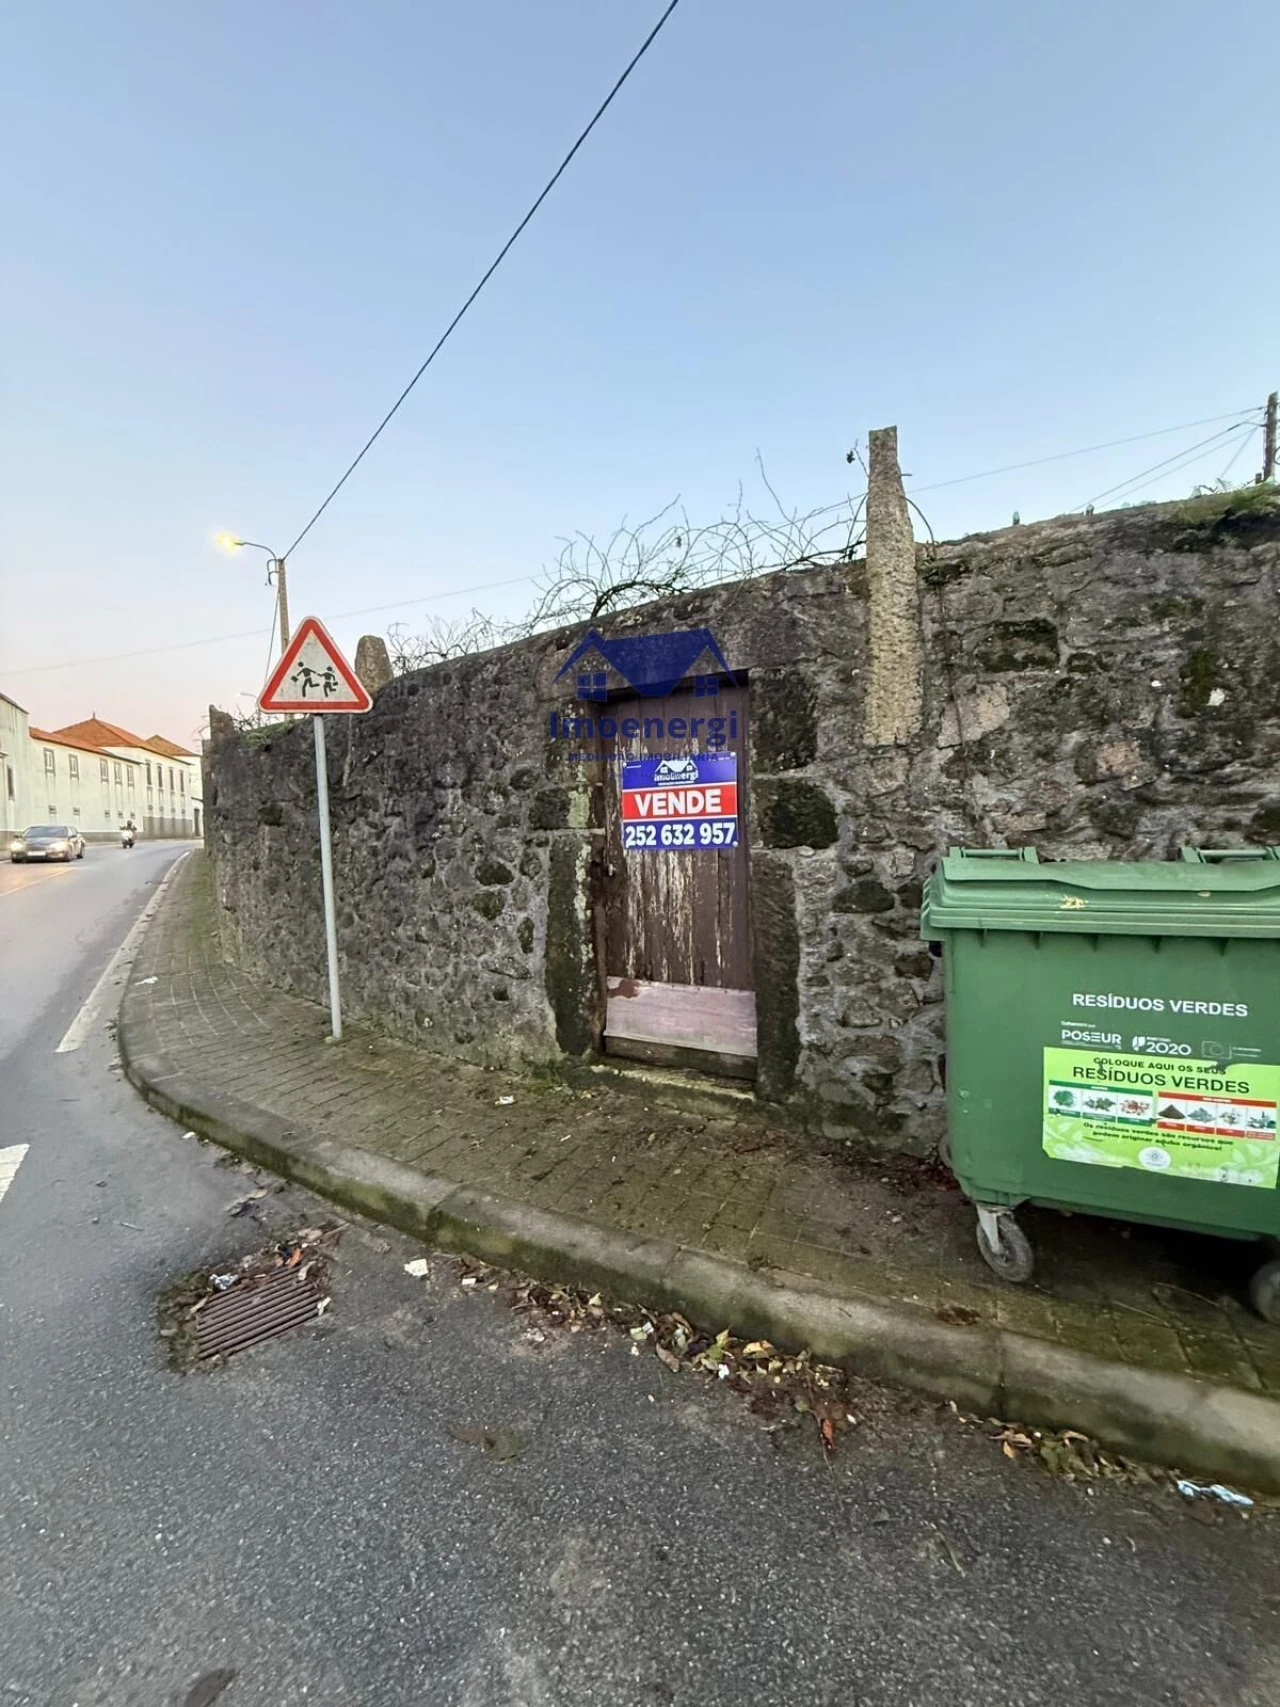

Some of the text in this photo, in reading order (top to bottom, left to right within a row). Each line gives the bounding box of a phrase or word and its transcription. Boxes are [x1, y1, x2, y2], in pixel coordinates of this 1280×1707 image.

[634, 788, 722, 817] VENDE
[625, 822, 736, 846] 252 632 957
[1072, 993, 1249, 1017] RESÍDUOS VERDES
[1061, 1029, 1122, 1044] POSEUR
[1146, 1041, 1192, 1055] 2020
[1093, 1057, 1144, 1069] COLOQUE
[1148, 1062, 1175, 1071] AQUI
[1196, 1066, 1226, 1075] SEUS
[1072, 1066, 1250, 1094] RESÍDUOS VERDES
